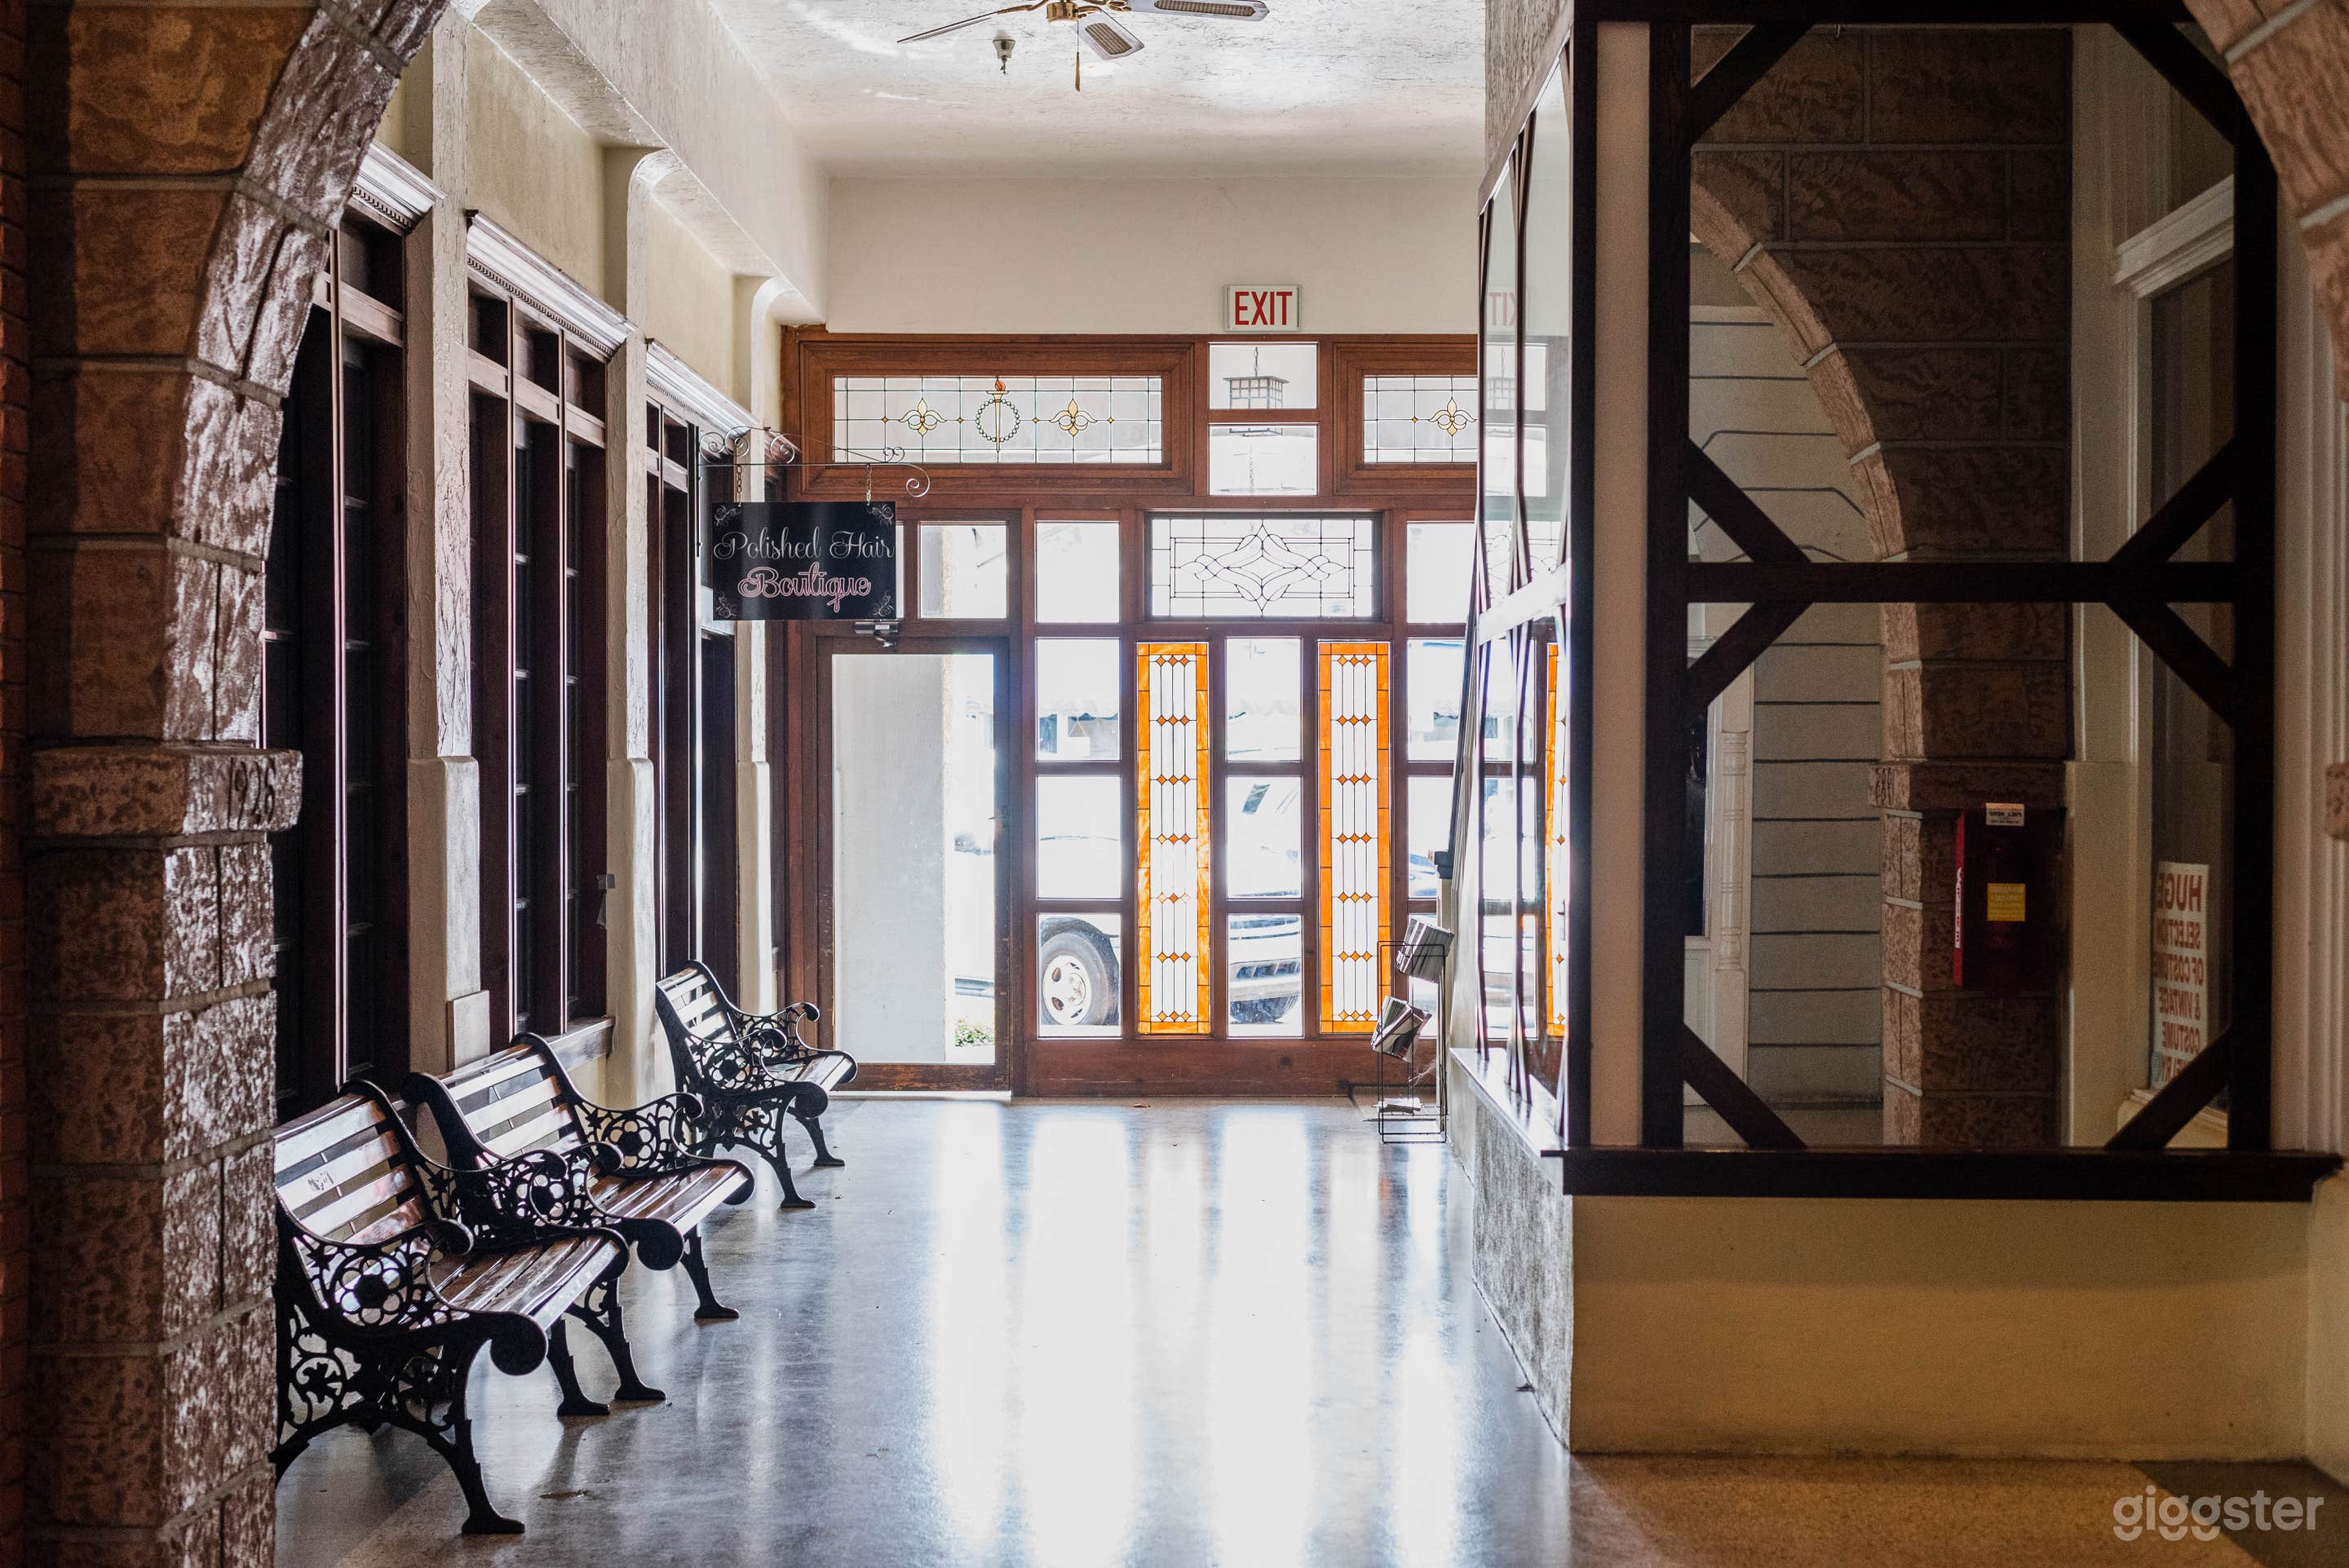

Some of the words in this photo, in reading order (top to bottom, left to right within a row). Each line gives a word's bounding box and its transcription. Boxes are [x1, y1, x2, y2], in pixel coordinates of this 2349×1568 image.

[1234, 291, 1293, 325] EXIT
[714, 526, 821, 560] Polished
[829, 531, 895, 559] Hair
[737, 562, 871, 612] Boutique
